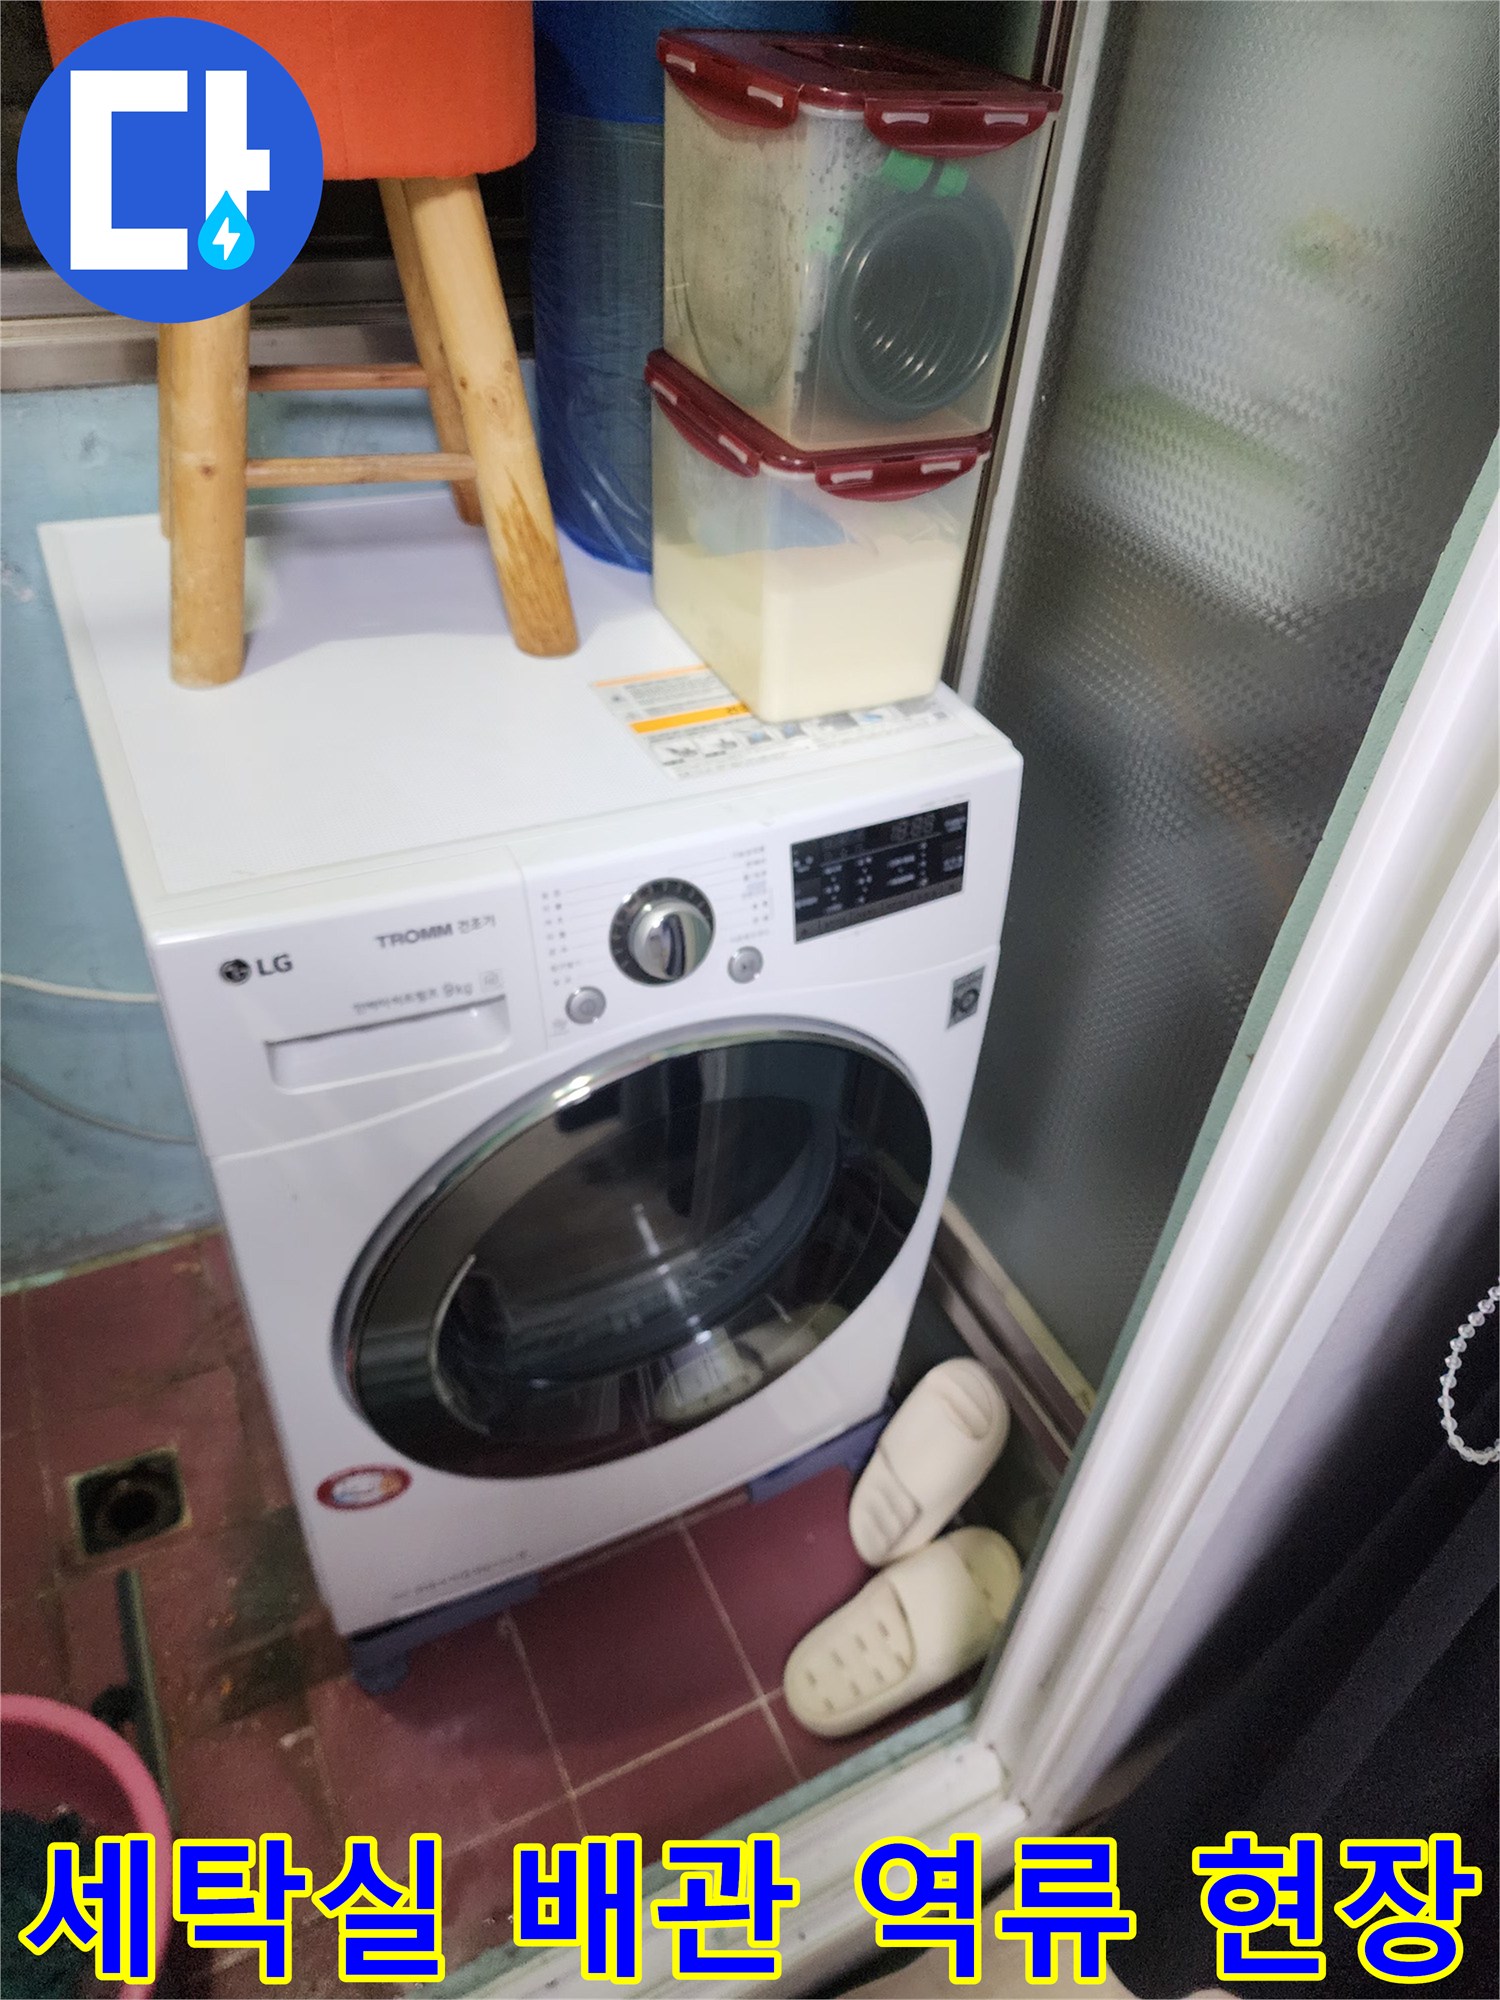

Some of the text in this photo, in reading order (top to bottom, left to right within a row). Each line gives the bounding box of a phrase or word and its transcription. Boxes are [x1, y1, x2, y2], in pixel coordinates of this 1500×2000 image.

[374, 914, 497, 949] TROMM 건조기
[256, 953, 293, 977] LG
